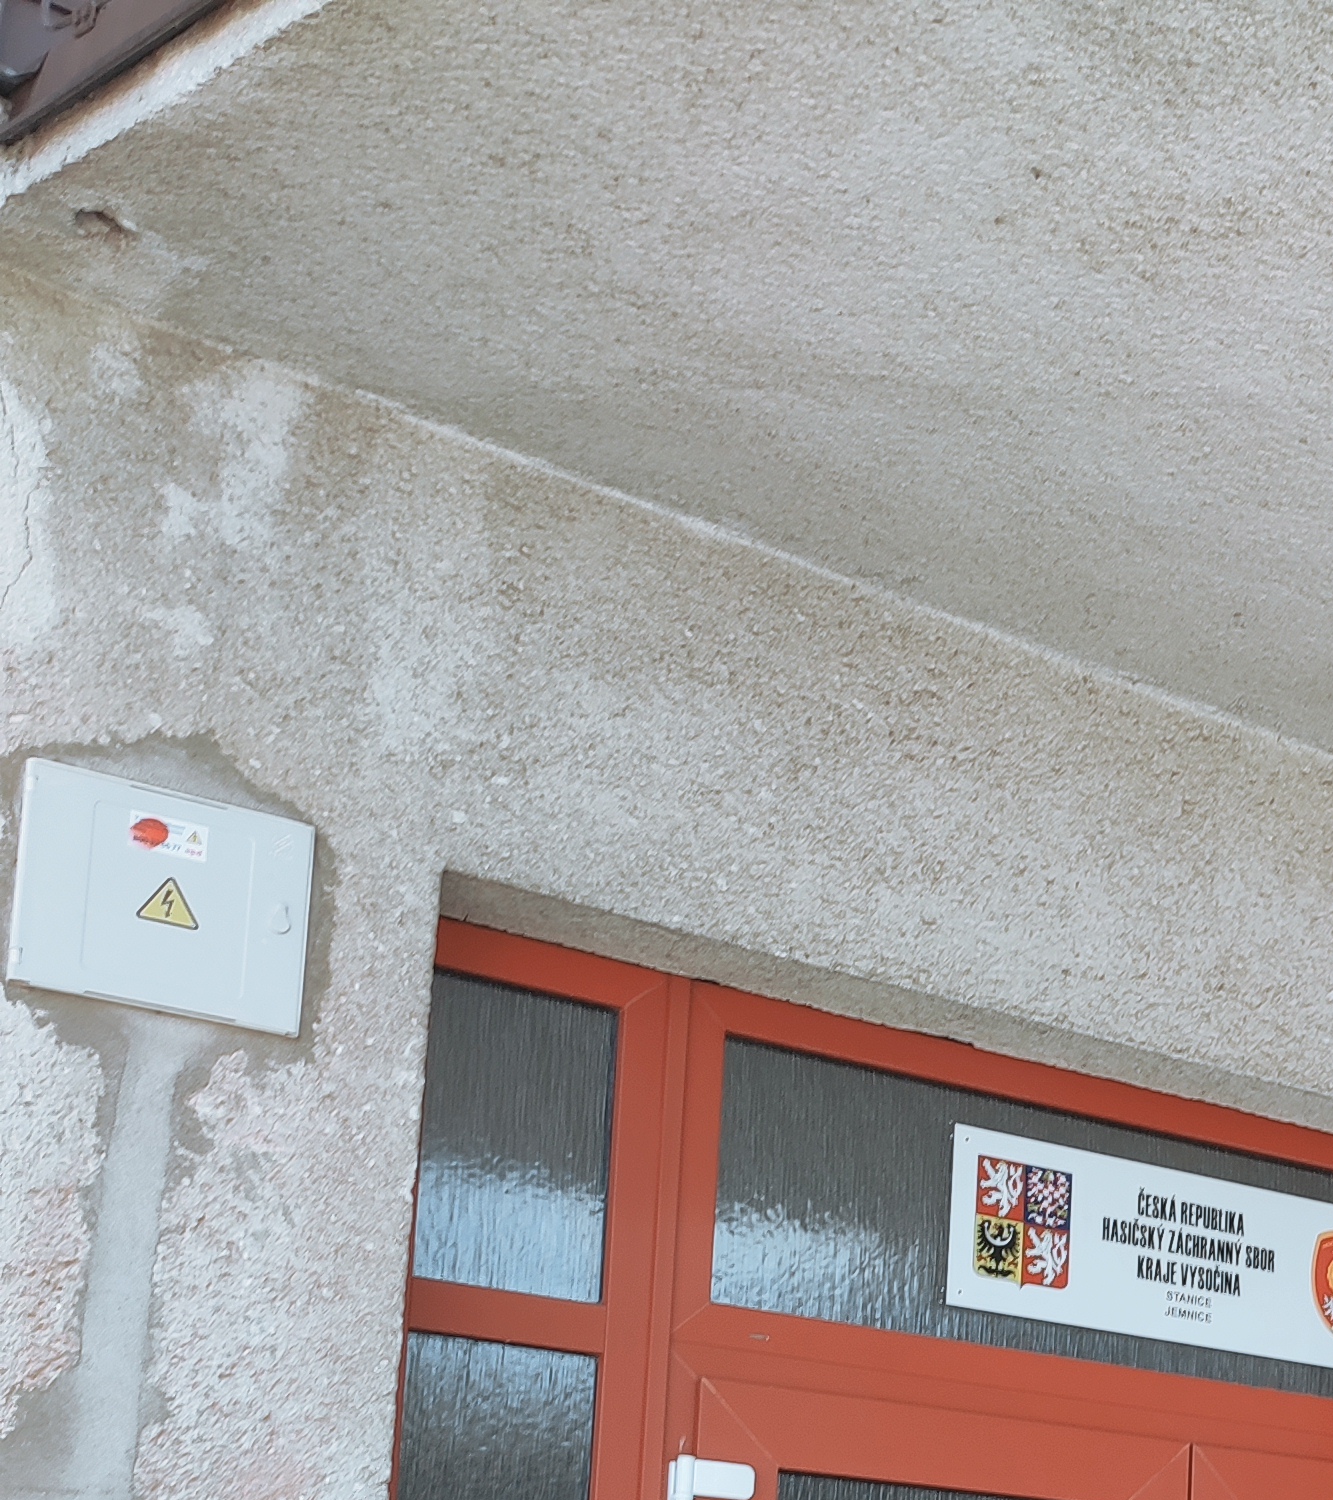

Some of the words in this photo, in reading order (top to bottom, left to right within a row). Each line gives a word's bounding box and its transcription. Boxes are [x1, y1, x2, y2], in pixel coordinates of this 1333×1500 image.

[1137, 1186, 1177, 1223] ČESKÁ
[1180, 1201, 1245, 1237] REPUBLIKA
[1102, 1216, 1165, 1251] HASIČSKÝ
[1168, 1227, 1242, 1266] ZÁCHRANNÝ
[1245, 1245, 1275, 1273] SBOR
[1137, 1254, 1177, 1285] KRAJE
[1180, 1264, 1241, 1297] VYSOČINA
[1164, 1306, 1212, 1324] JEMNICE
[1165, 1290, 1212, 1308] STANICE
